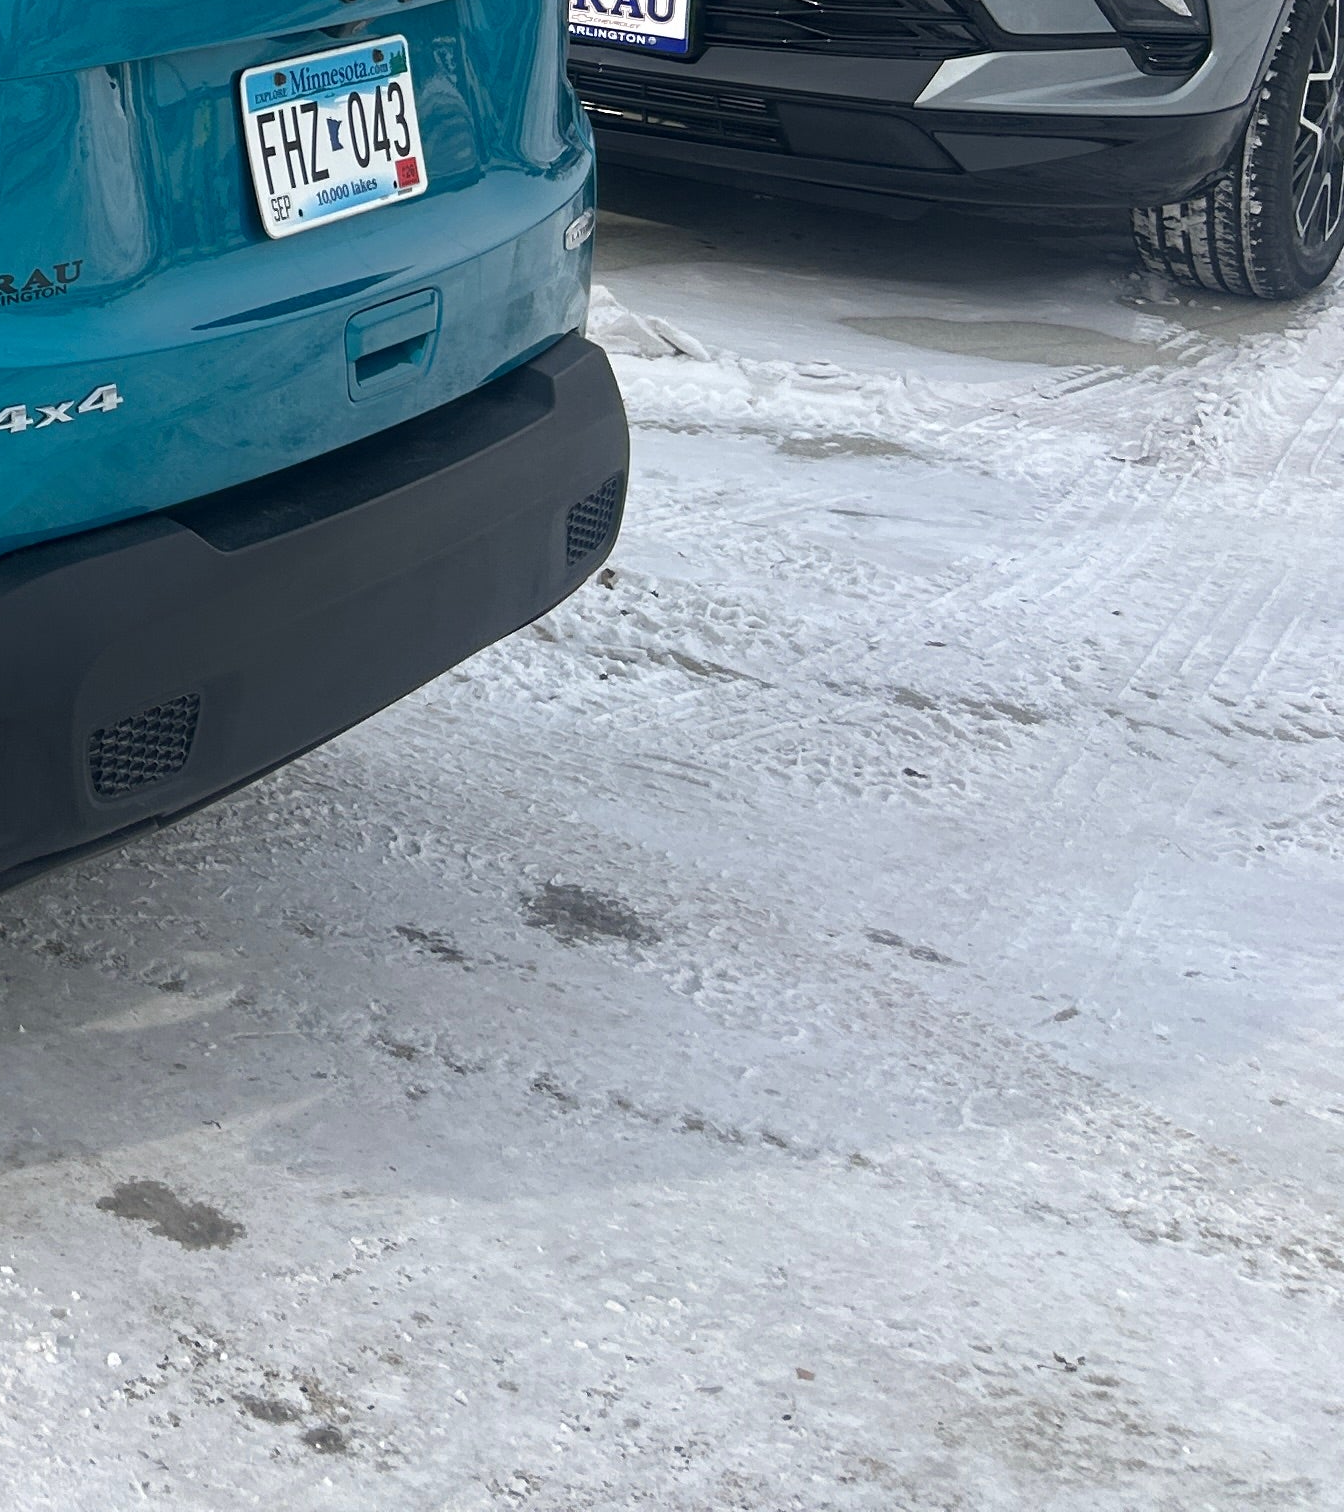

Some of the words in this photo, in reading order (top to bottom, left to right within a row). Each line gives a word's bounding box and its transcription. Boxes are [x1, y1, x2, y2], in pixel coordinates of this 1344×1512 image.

[568, 23, 646, 45] ARLINGTON
[289, 60, 389, 94] Minnesota.com
[256, 100, 330, 195] FHZ
[347, 81, 411, 168] 043
[315, 183, 351, 206] 10,000
[352, 177, 378, 196] lakes
[270, 194, 292, 222] SEP
